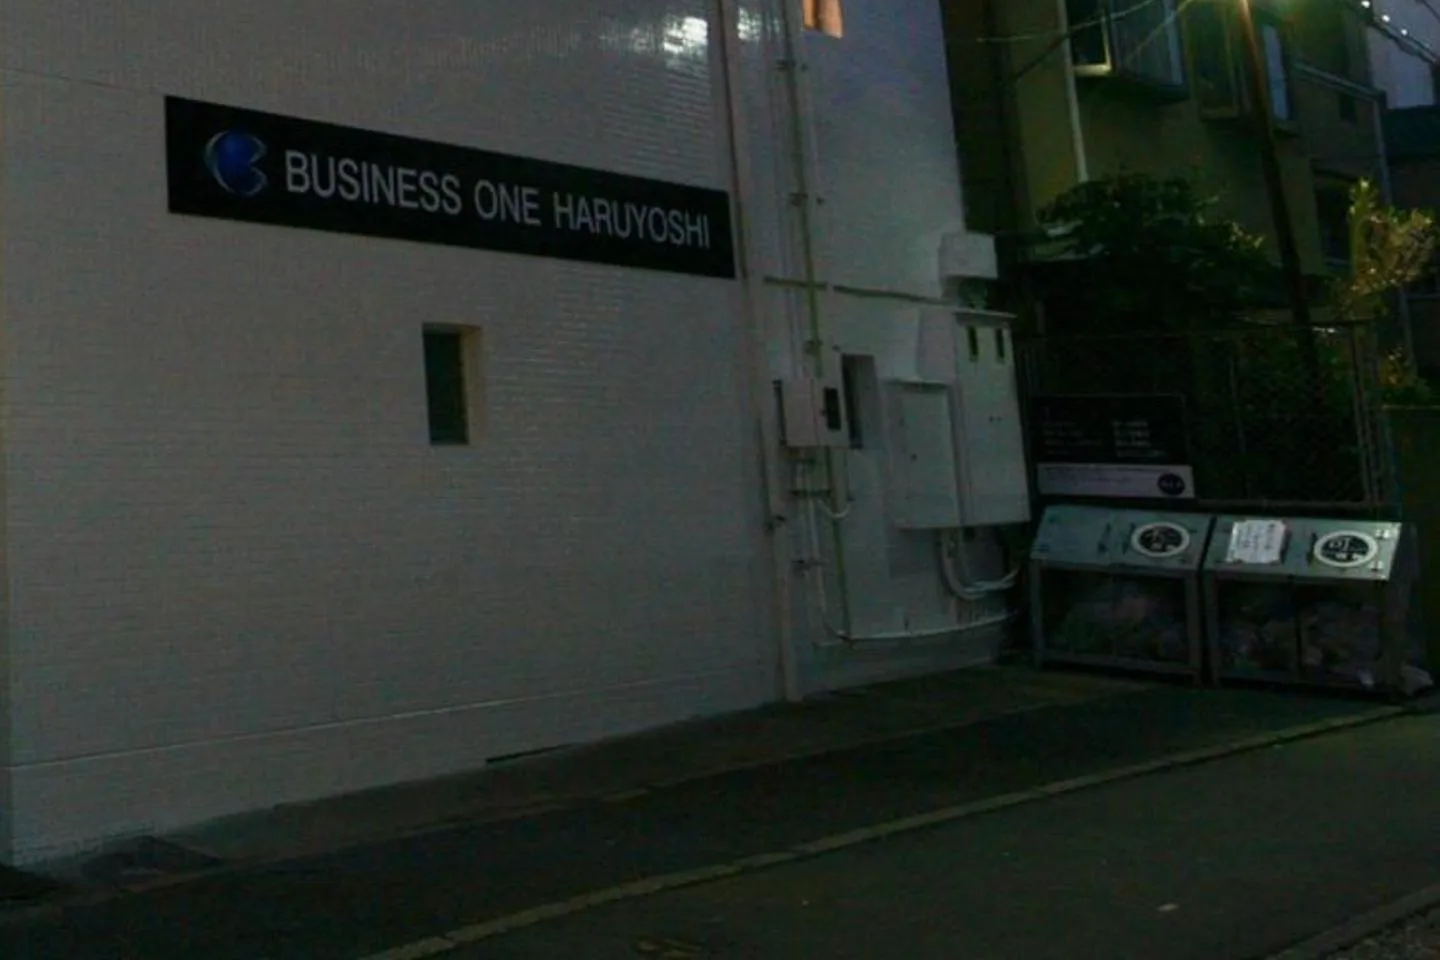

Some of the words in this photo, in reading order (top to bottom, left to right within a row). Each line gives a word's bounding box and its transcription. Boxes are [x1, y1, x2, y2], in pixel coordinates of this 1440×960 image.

[283, 149, 462, 215] BUSINESS
[473, 179, 541, 227] ONE
[553, 191, 711, 249] HARUYOSHI
